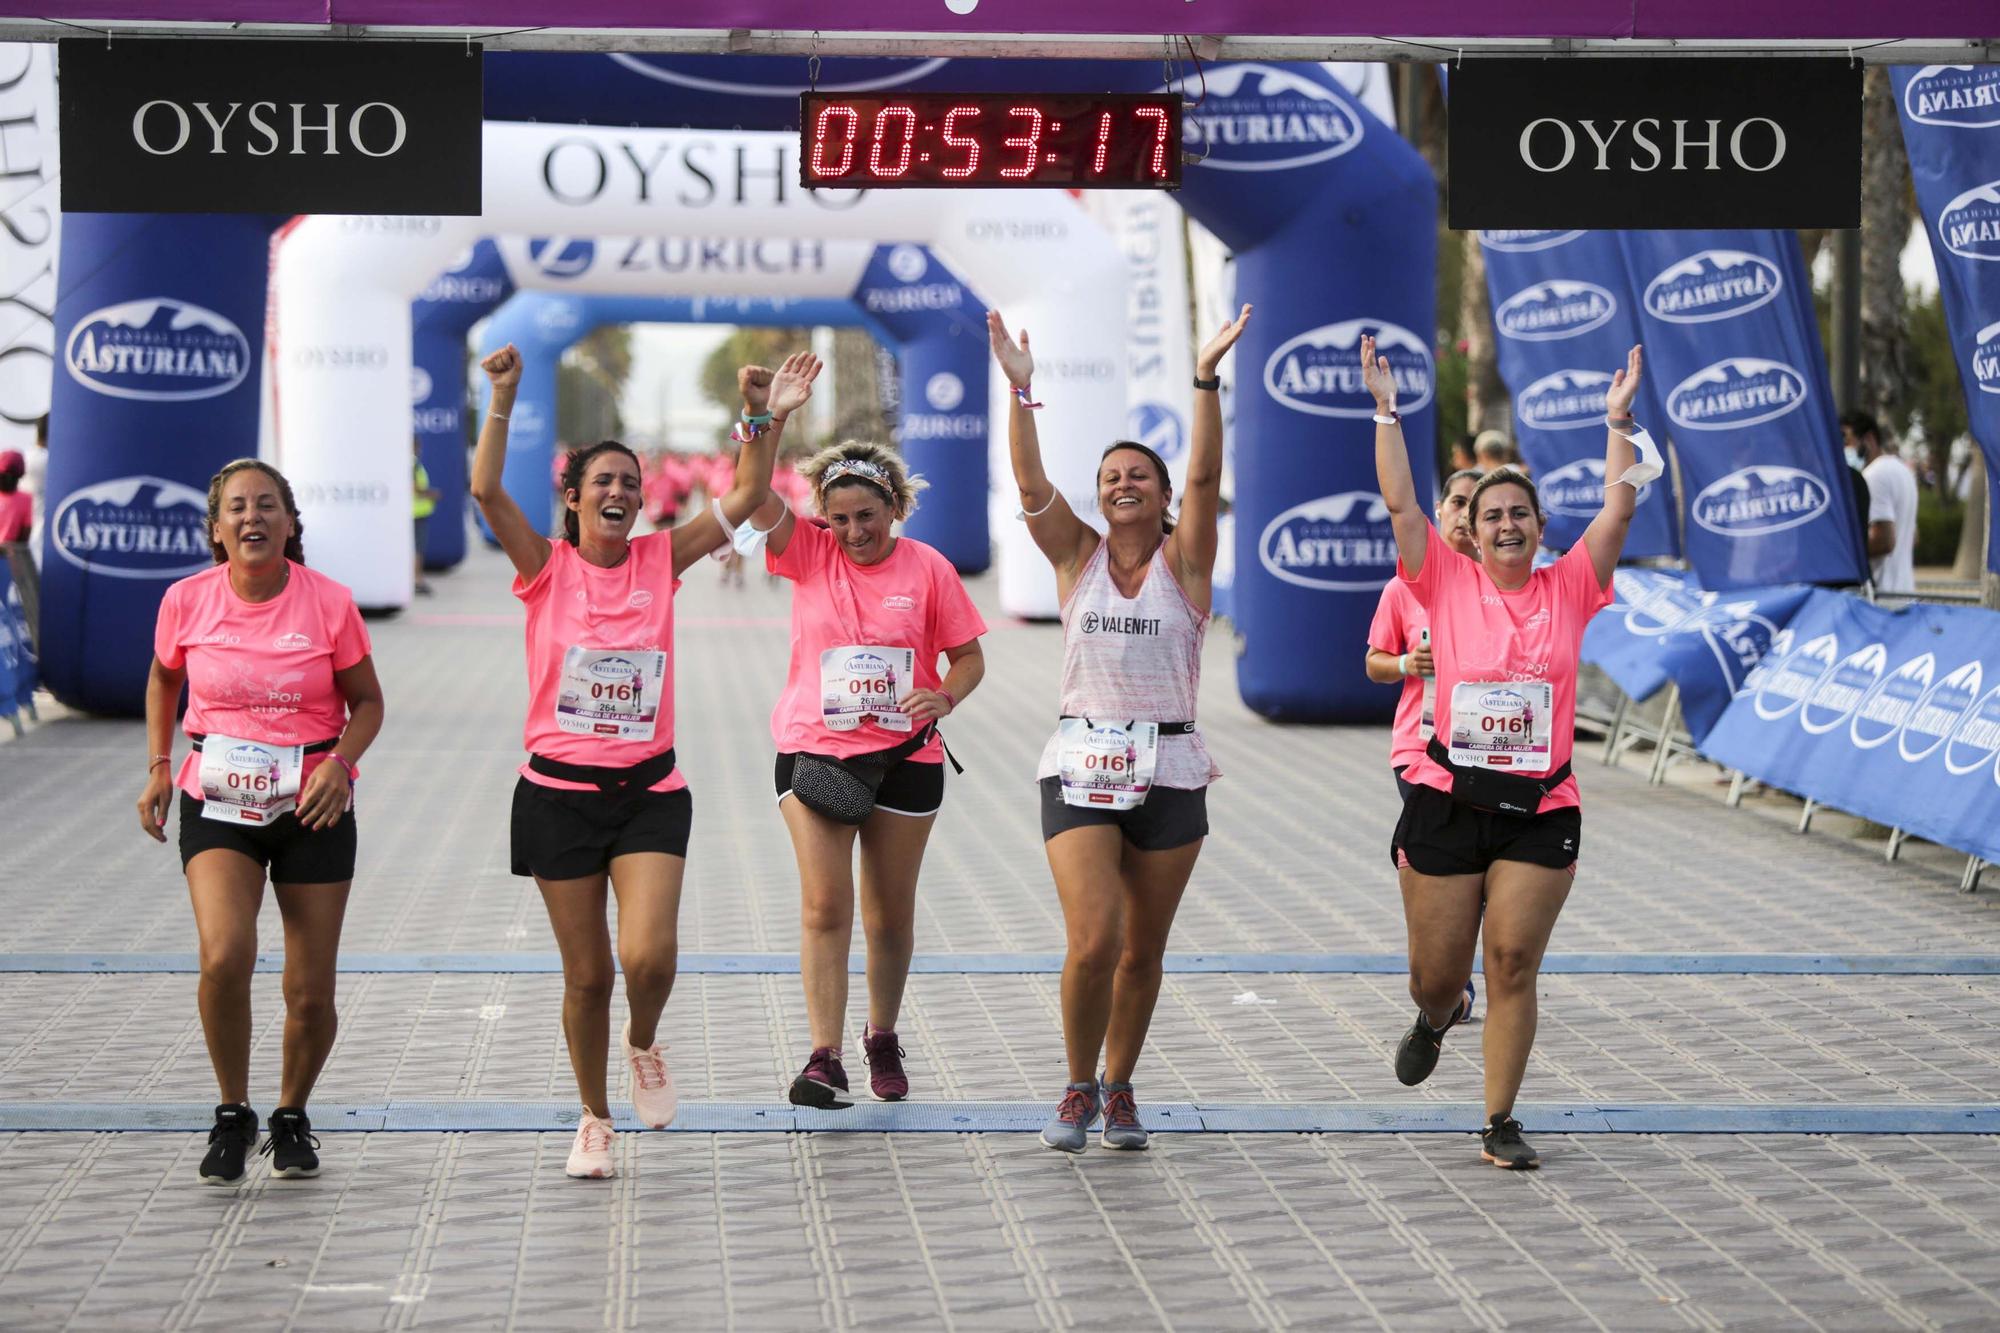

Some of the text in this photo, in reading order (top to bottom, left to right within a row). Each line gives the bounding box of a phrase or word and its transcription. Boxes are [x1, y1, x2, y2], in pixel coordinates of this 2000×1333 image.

[132, 99, 407, 158] OYSHO
[1182, 112, 1350, 145] STURIANA
[812, 106, 1168, 177] 00:53:17
[1519, 117, 1787, 173] OYSHO
[73, 329, 240, 379] ASTURIANA
[62, 507, 210, 556] ASTURIAN
[1101, 616, 1161, 636] VALENFIT
[591, 682, 631, 701] 016
[849, 678, 887, 694] 016
[268, 690, 303, 703] POR
[860, 697, 875, 705] 267
[599, 703, 616, 712] 264
[611, 712, 620, 720] LA
[827, 717, 856, 727] OYSHO
[1481, 715, 1522, 733] 016
[1492, 736, 1508, 744] 262
[1085, 754, 1124, 771] 016
[1452, 752, 1484, 763] OYSHO
[227, 772, 268, 791] 016
[1094, 774, 1110, 783] 265
[240, 793, 257, 801] 263
